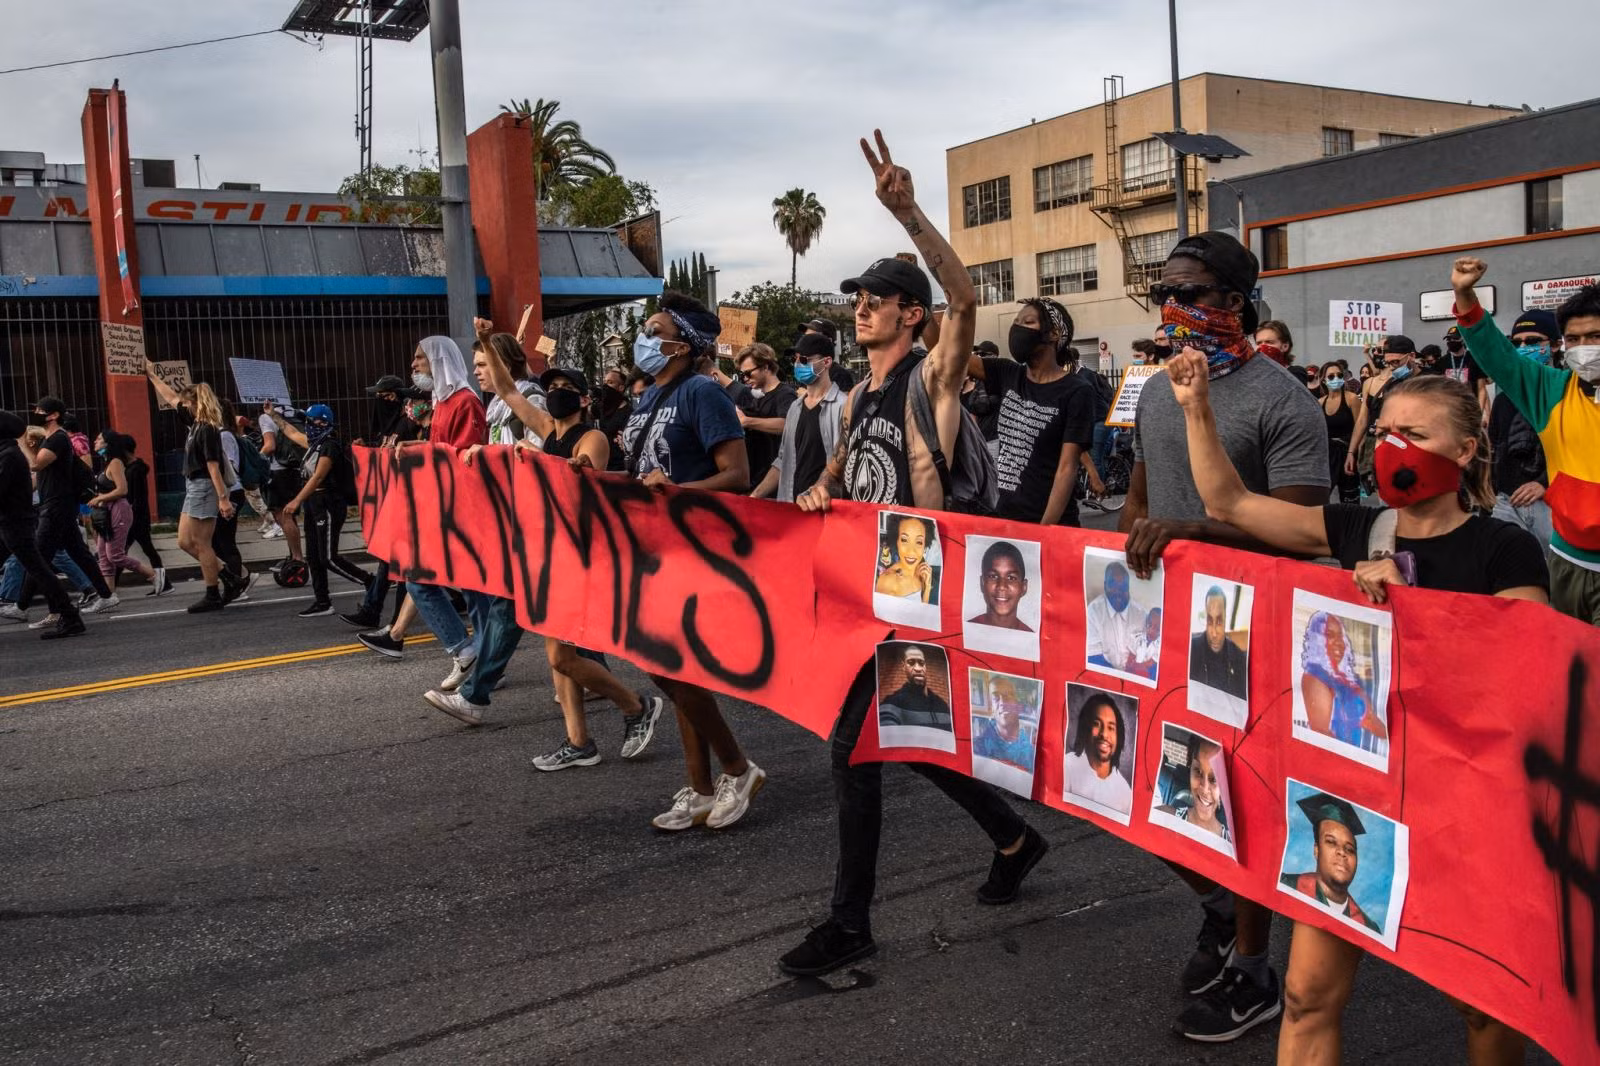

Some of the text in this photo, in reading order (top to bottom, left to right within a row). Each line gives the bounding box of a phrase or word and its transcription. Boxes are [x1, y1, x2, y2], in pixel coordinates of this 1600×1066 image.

[1347, 302, 1380, 316] STOP
[1343, 316, 1388, 331] POLICE
[1334, 331, 1388, 346] BRUTALI
[105, 340, 136, 351] Eric Garner
[108, 357, 127, 369] George
[1128, 366, 1164, 377] AMBE
